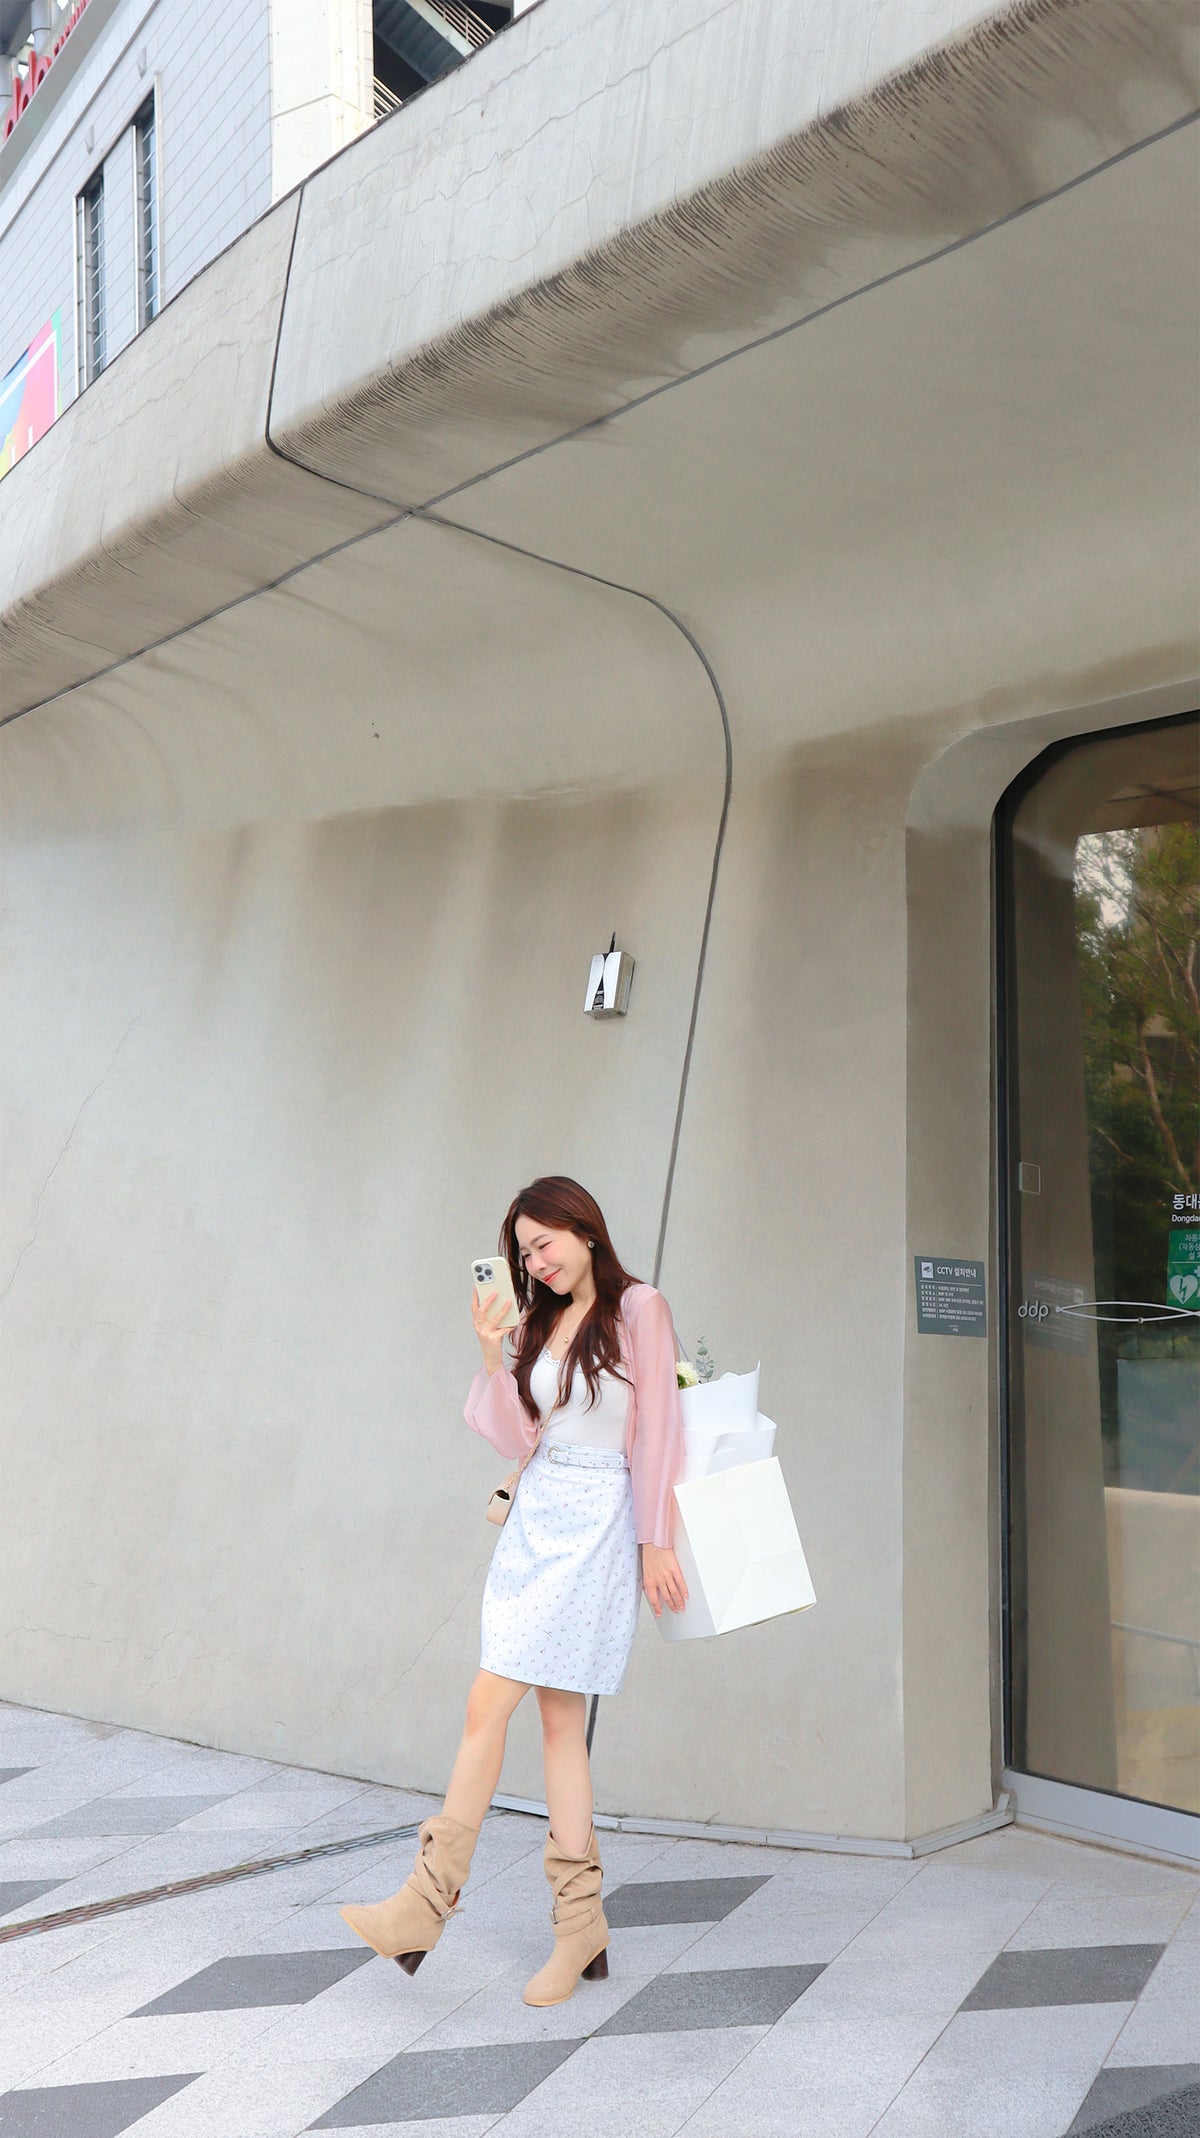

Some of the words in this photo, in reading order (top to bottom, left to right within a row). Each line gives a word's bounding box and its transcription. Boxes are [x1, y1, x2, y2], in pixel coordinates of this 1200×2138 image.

[1172, 1193, 1200, 1210] 동대
[1184, 1233, 1200, 1242] 자동
[936, 1266, 953, 1276] CCTV
[1018, 1300, 1049, 1323] ddp
